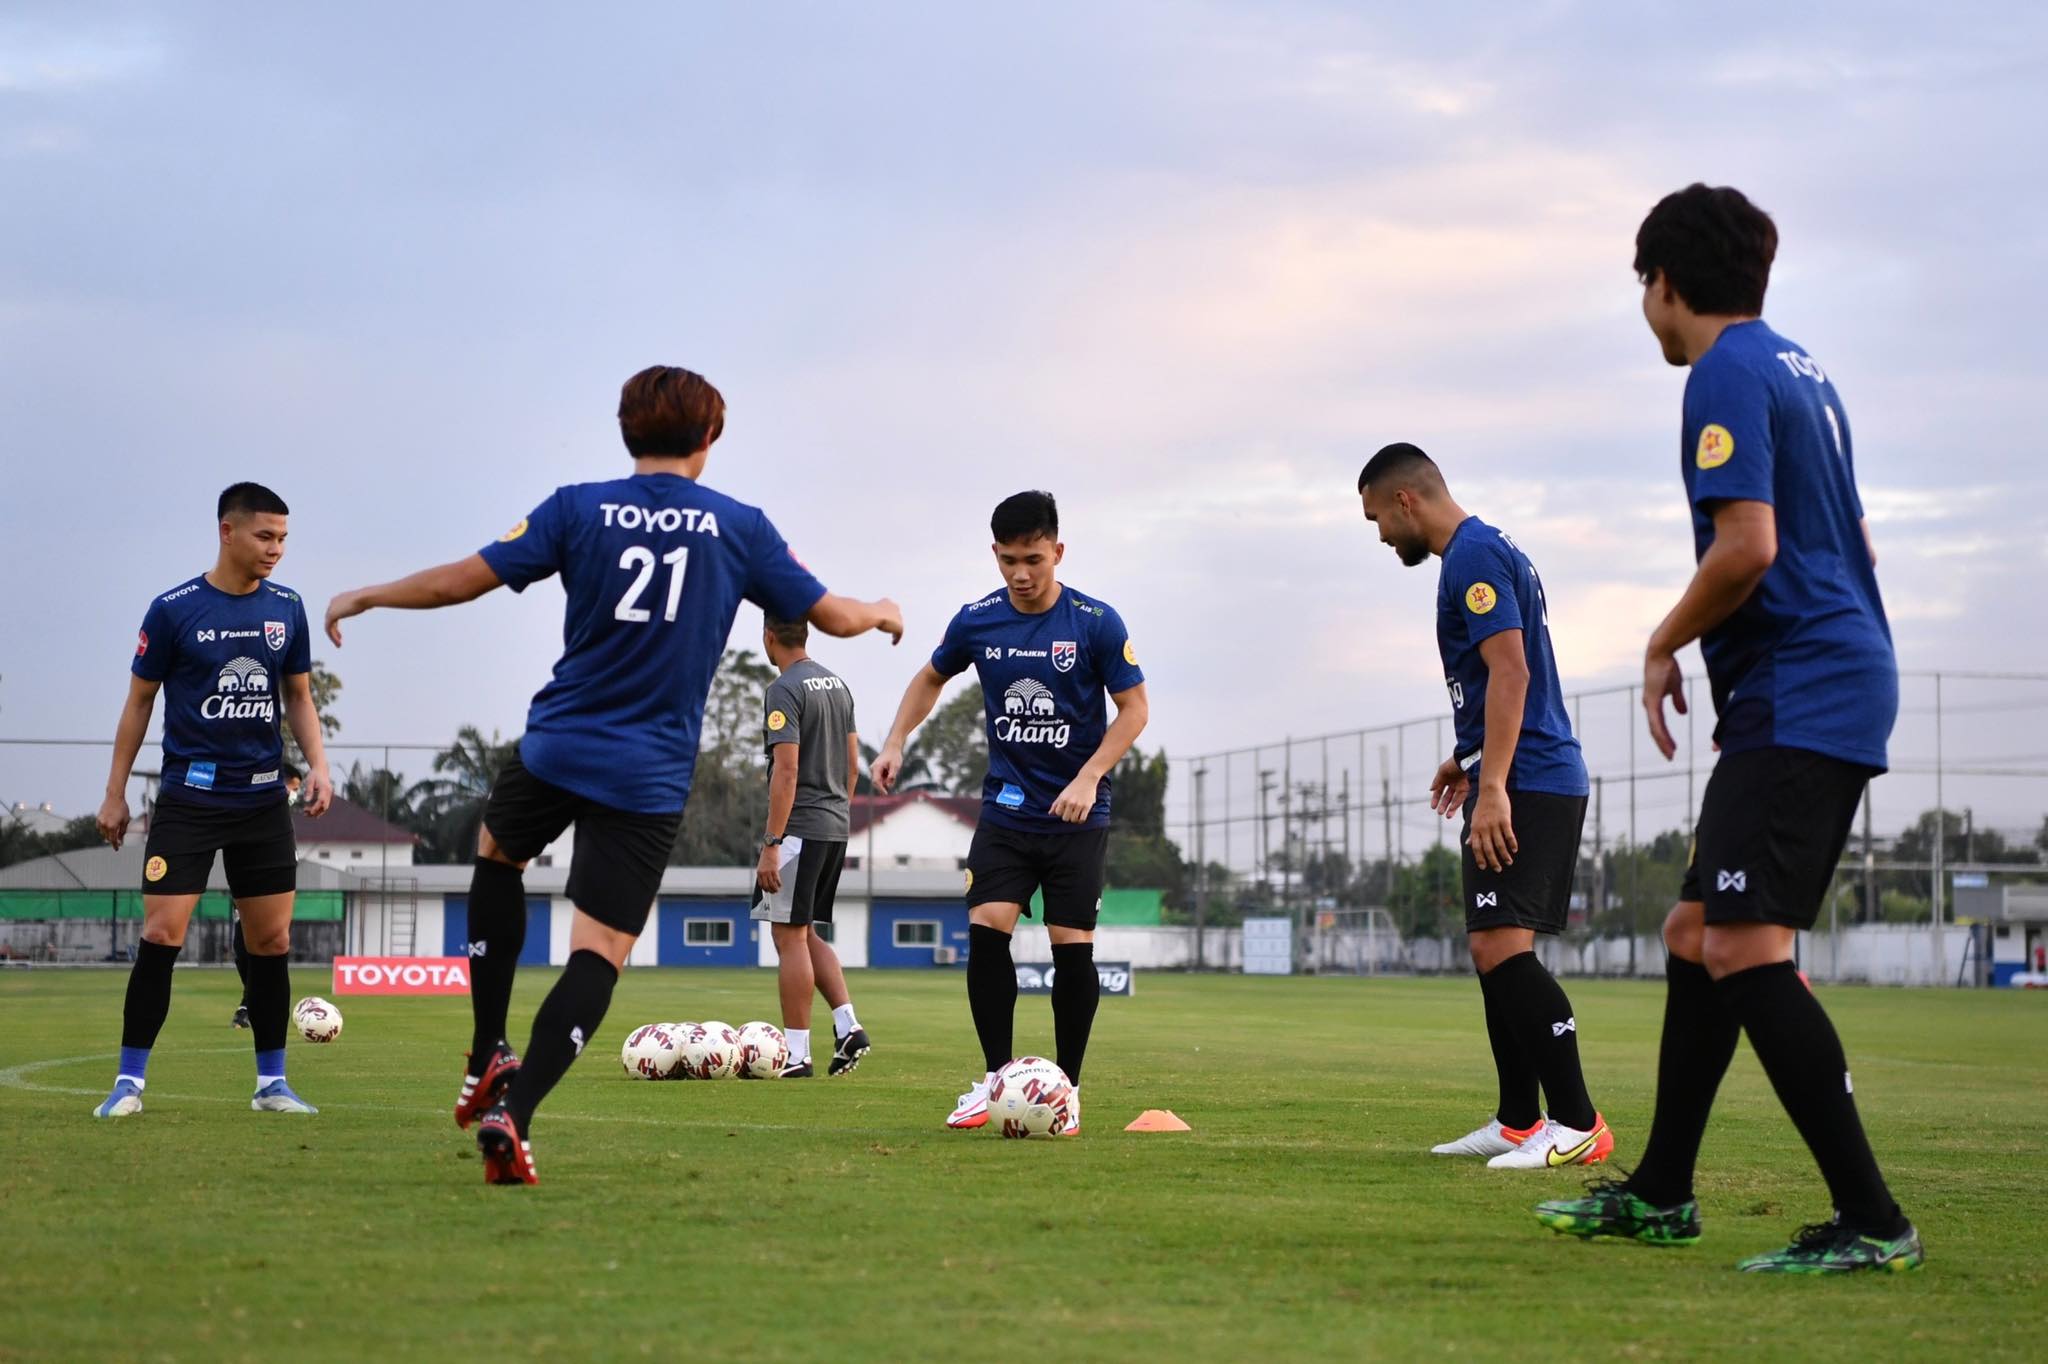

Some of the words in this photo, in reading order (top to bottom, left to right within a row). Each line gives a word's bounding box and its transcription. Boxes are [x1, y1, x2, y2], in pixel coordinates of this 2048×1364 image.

[600, 503, 719, 538] TOYOTA
[161, 584, 200, 602] TOYOTA
[614, 546, 688, 622] 21
[968, 596, 1003, 612] TOYOTA
[1079, 604, 1093, 613] AIS
[1015, 650, 1048, 658] DAIKIN
[803, 676, 845, 691] TOYOTA
[200, 695, 274, 723] Chang
[994, 716, 1070, 748] Chang
[338, 965, 467, 985] TOYOTA
